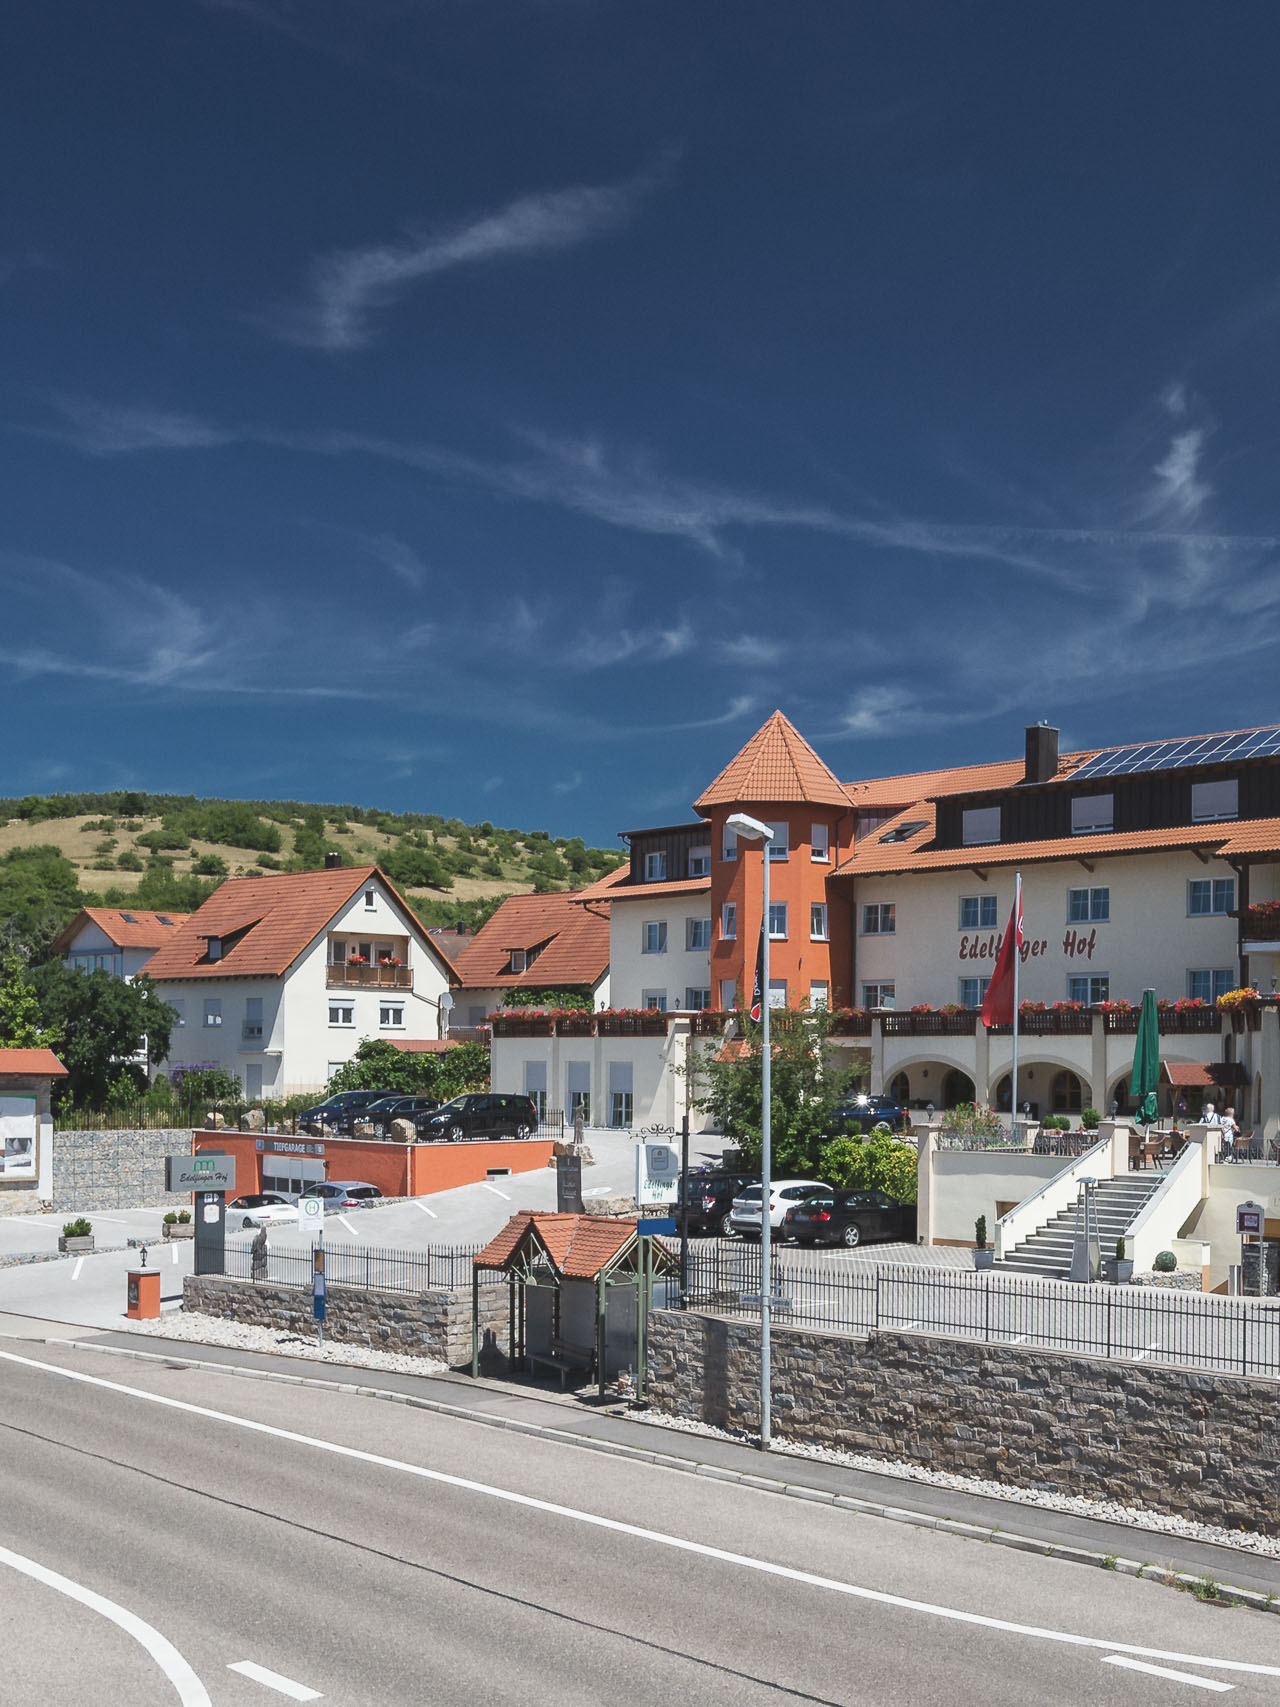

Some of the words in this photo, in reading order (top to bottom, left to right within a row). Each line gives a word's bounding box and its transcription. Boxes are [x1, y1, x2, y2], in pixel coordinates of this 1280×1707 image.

[959, 934, 1047, 963] Edelfger
[1063, 928, 1097, 960] Hof
[273, 1142, 306, 1153] TIEFGARAGE
[180, 1172, 214, 1183] Edelfinger
[215, 1172, 228, 1182] Hof
